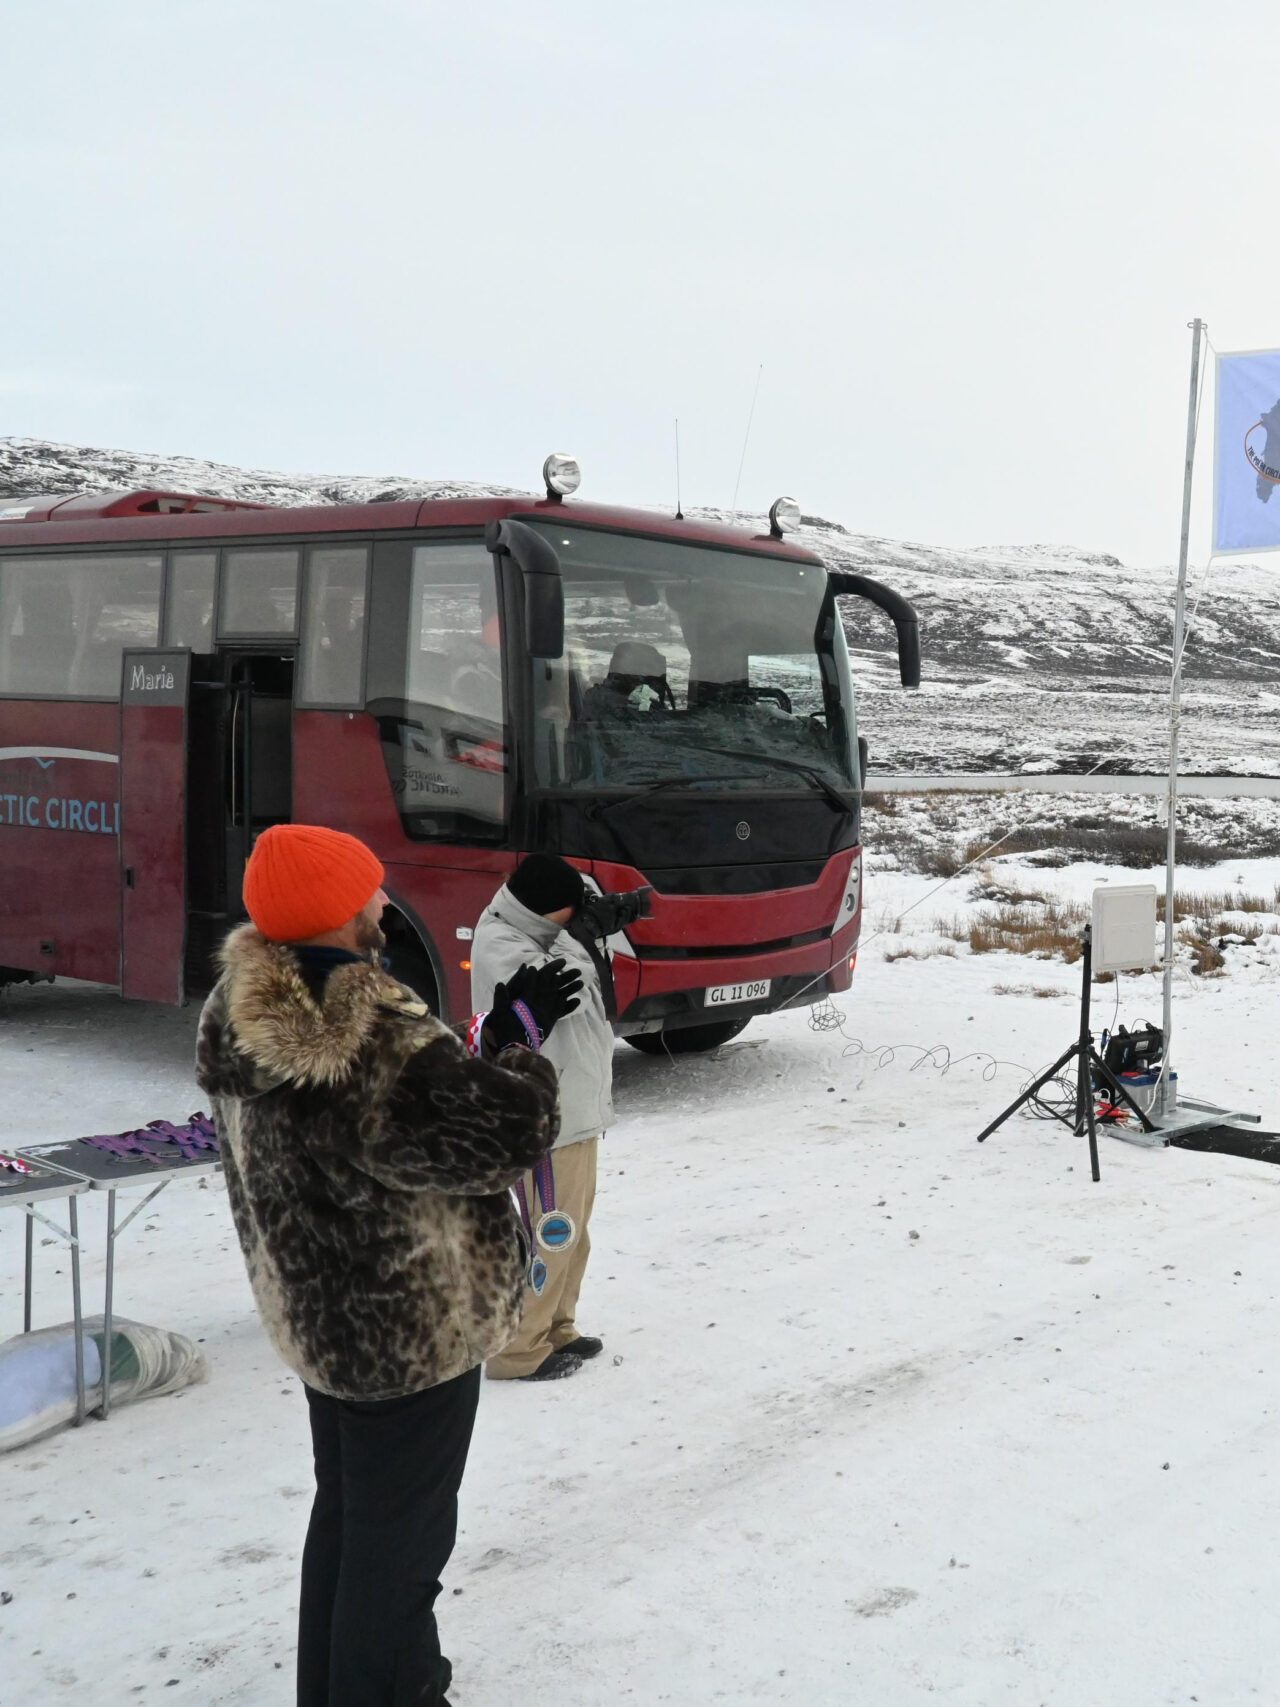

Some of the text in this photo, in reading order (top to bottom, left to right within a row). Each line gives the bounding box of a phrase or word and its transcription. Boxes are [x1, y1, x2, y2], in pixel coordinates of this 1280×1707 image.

[0, 794, 40, 826] TIC
[711, 982, 766, 1002] GL 11 096
